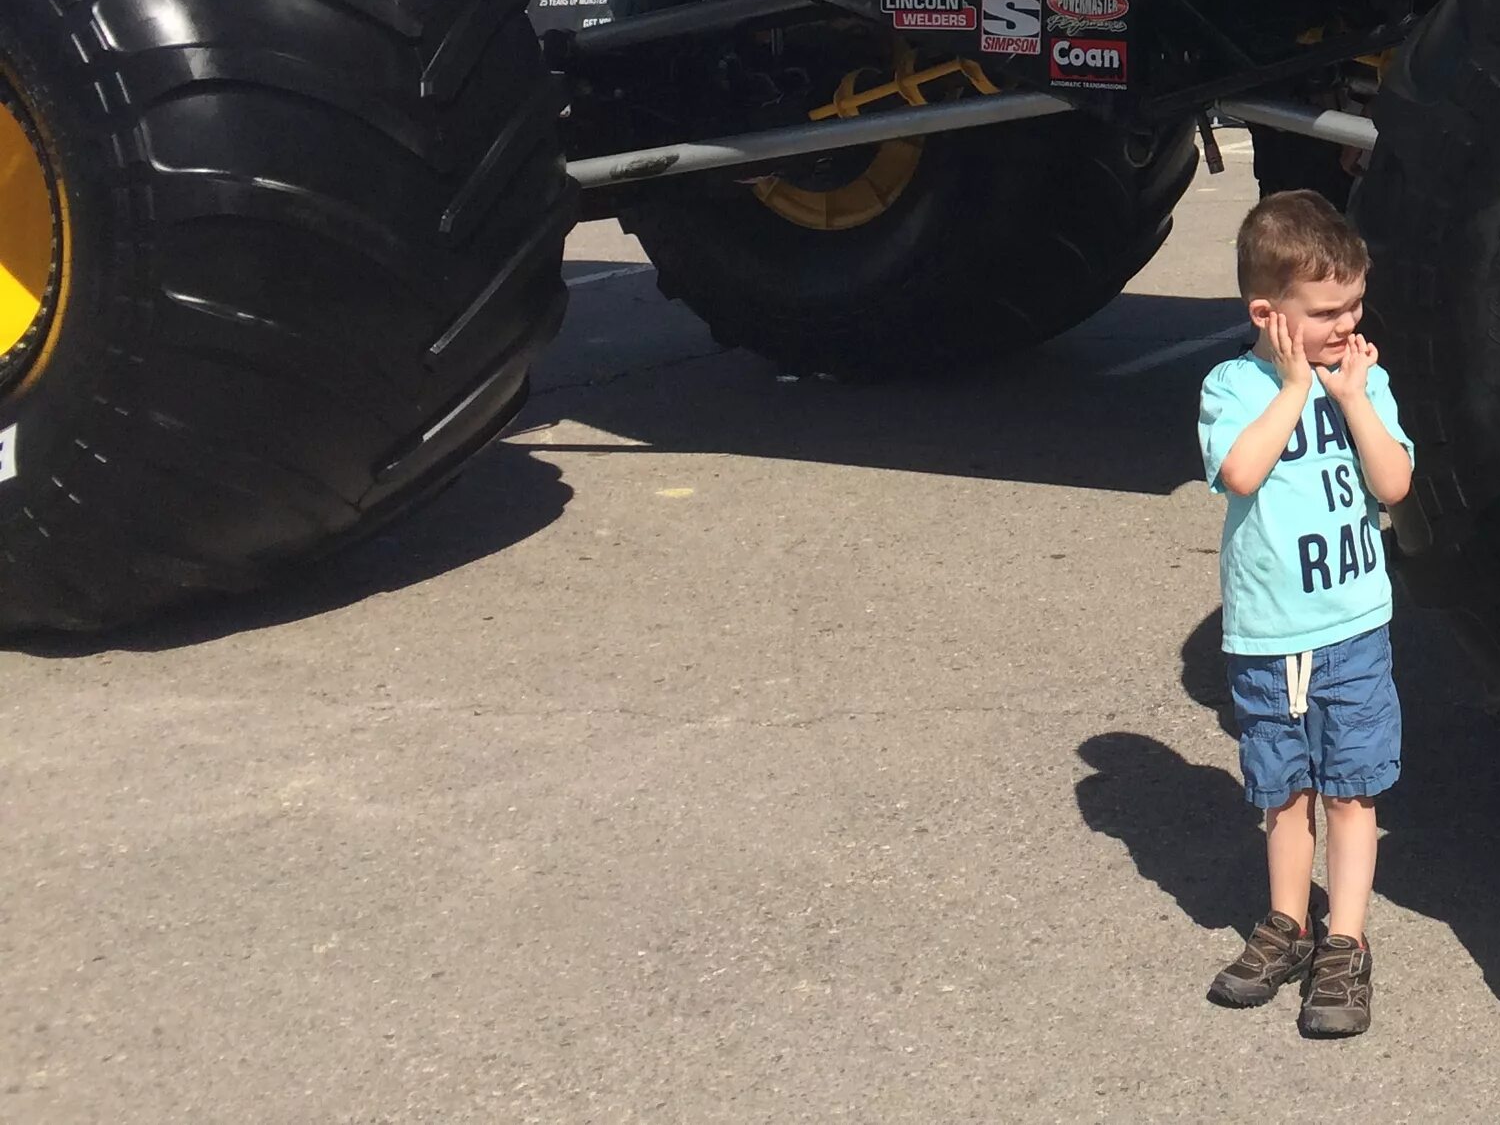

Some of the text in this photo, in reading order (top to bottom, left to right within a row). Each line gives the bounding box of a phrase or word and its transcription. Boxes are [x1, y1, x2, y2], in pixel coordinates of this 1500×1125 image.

[903, 13, 966, 26] WELDERS
[984, 37, 1038, 53] SIMPSON
[1053, 40, 1120, 68] Coan
[1322, 464, 1353, 512] IS
[1298, 515, 1377, 593] RAD
